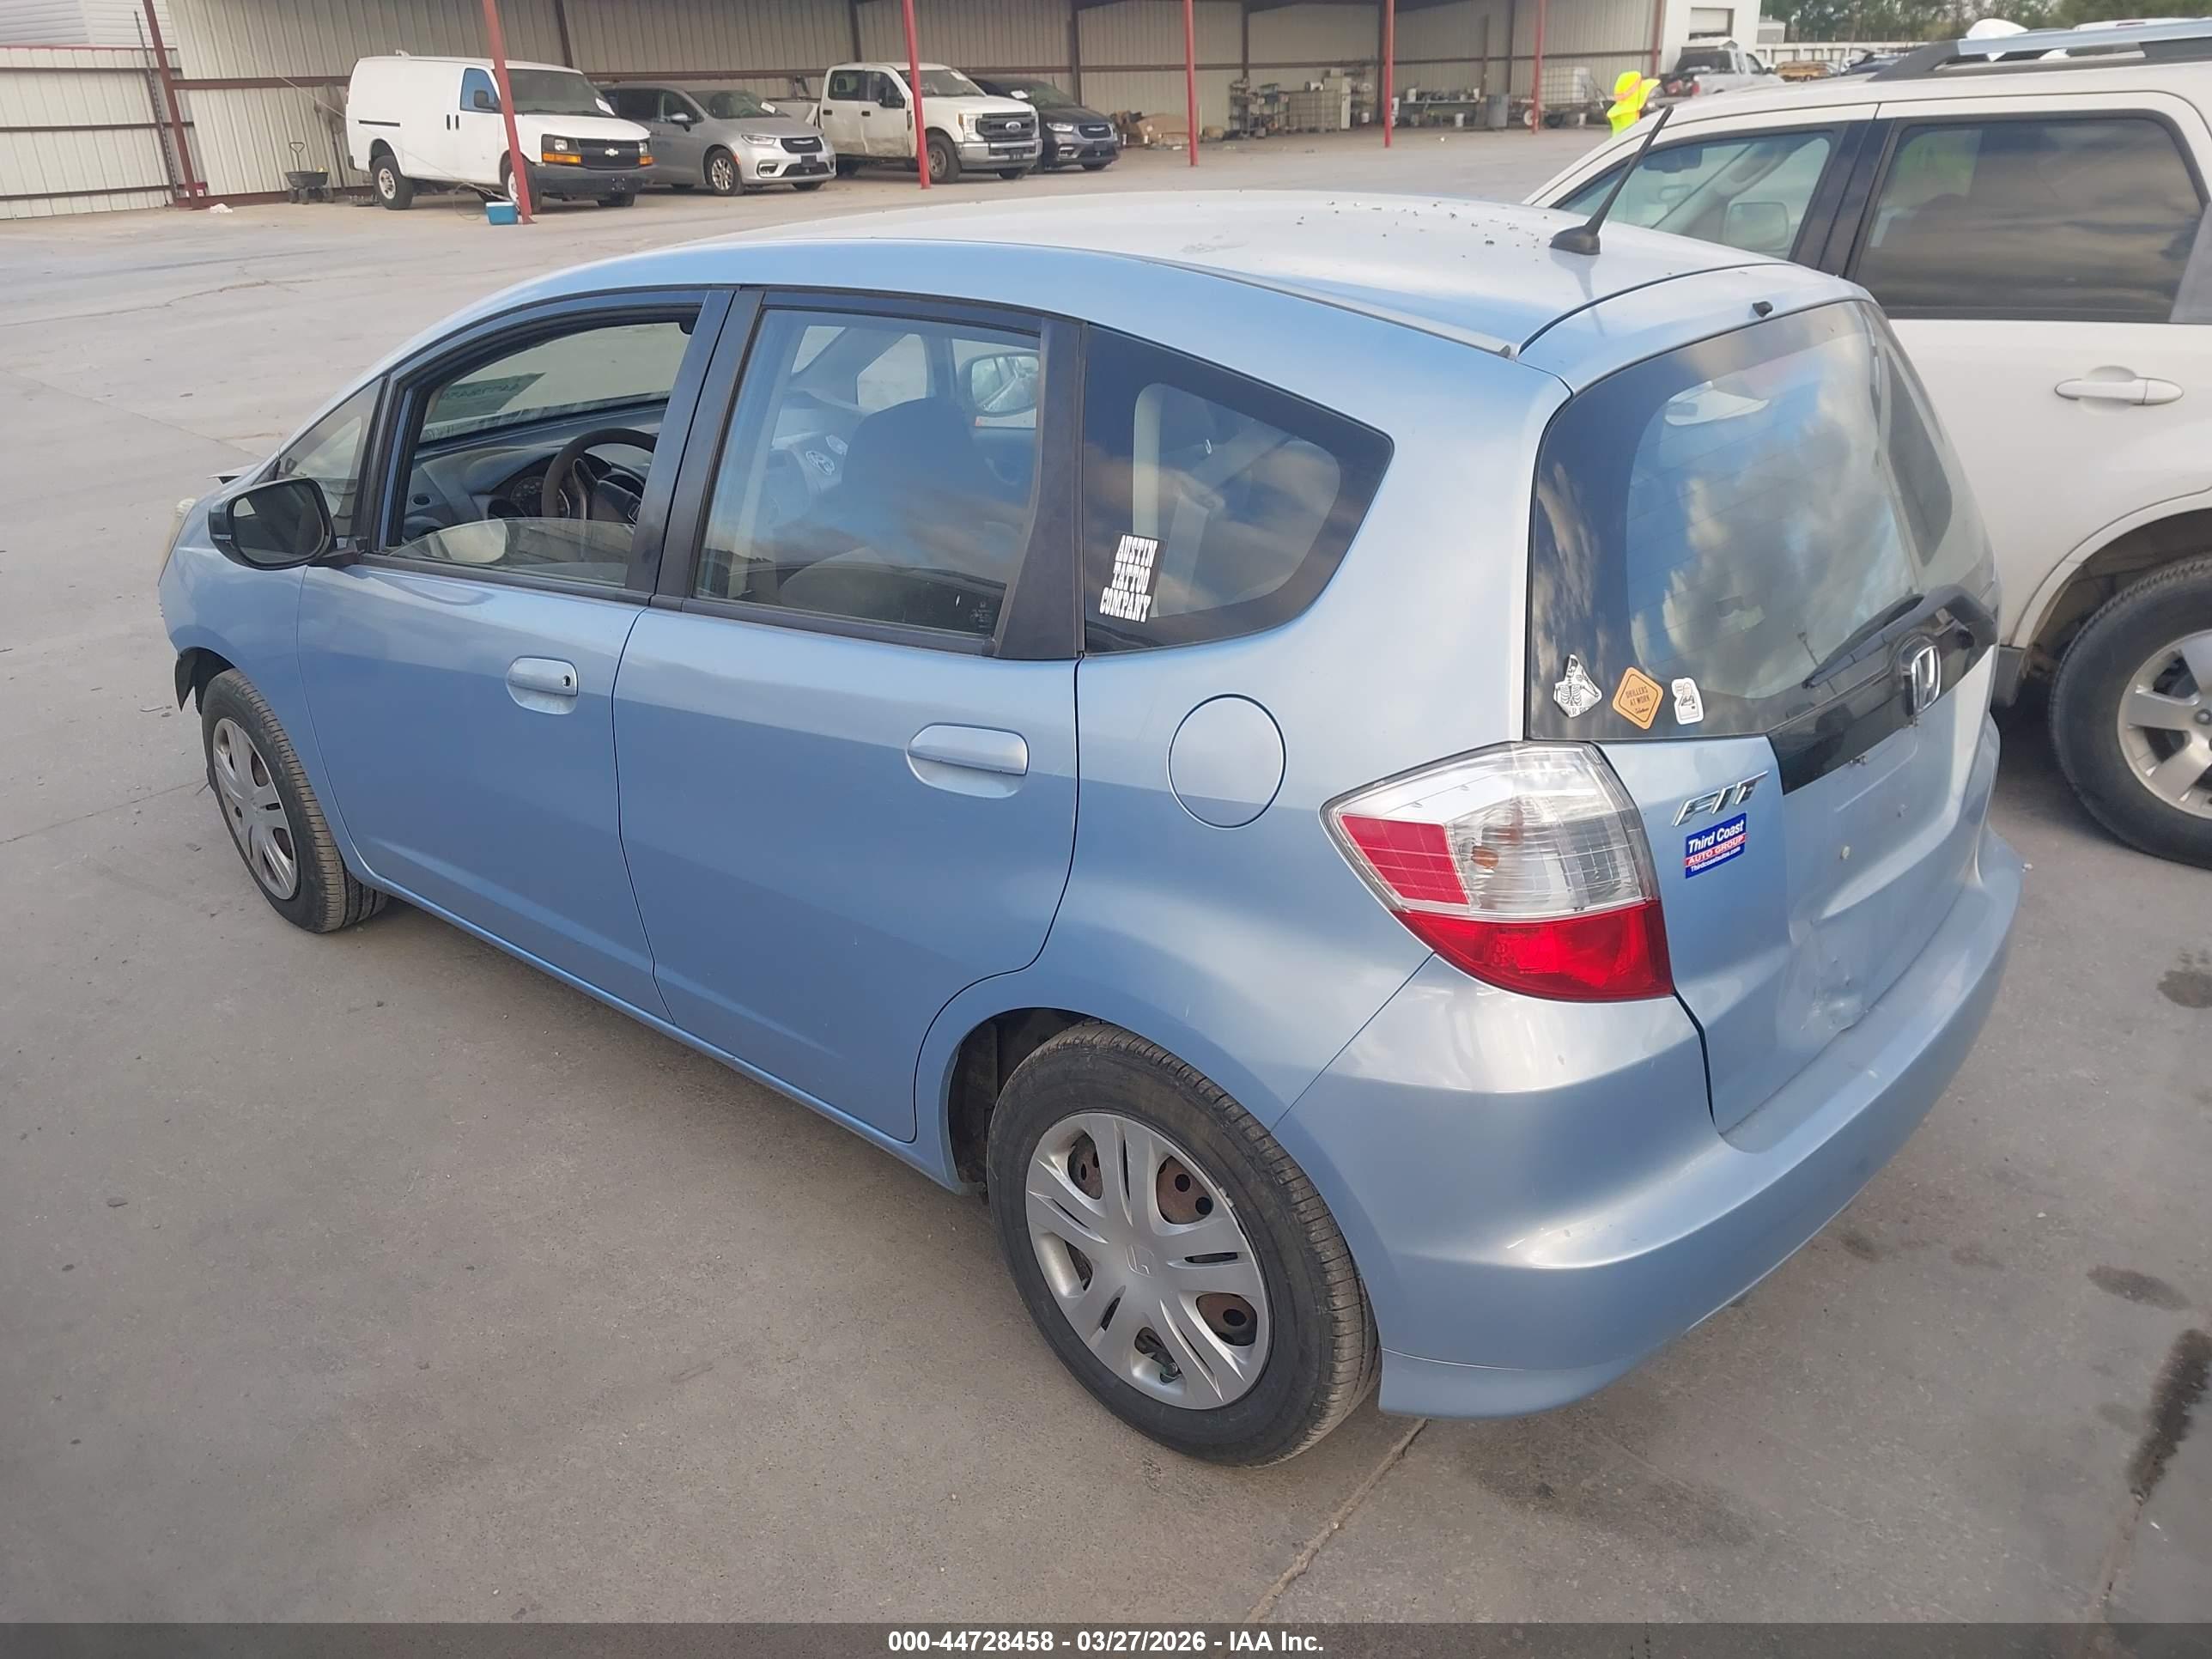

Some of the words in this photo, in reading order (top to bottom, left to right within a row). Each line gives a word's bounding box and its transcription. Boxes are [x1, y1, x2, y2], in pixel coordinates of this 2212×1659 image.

[1115, 534, 1158, 568] AUSTIN
[1111, 562, 1151, 594] TATTOO
[1099, 586, 1152, 623] COMPANY
[1672, 770, 1769, 827] FIT
[1688, 831, 1715, 854] Third
[1717, 819, 1744, 842] Coast
[1688, 849, 1713, 866] AUTO
[1714, 836, 1744, 854] GROUP
